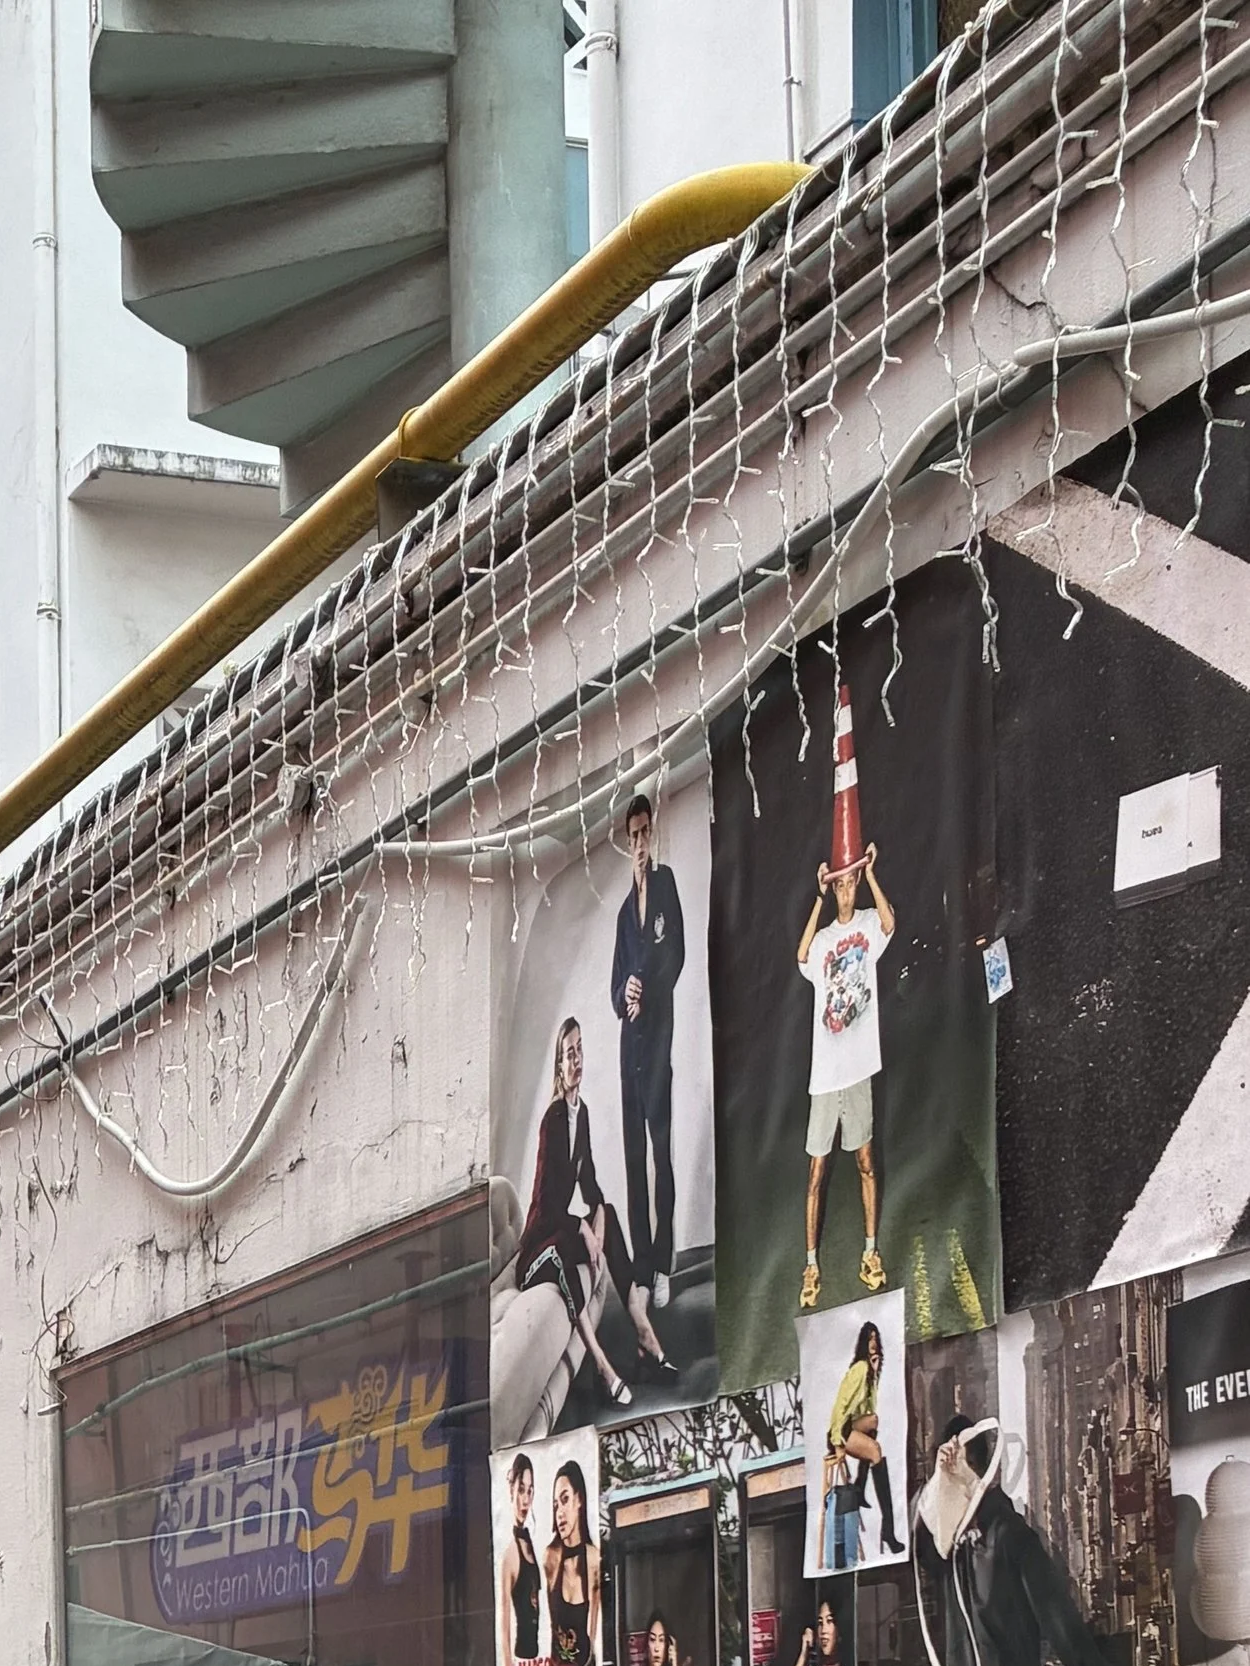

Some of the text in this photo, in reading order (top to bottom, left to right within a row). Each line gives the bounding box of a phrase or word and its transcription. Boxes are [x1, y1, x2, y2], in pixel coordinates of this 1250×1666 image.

[1185, 1381, 1210, 1412] THE
[175, 1553, 330, 1612] Western Mahua
